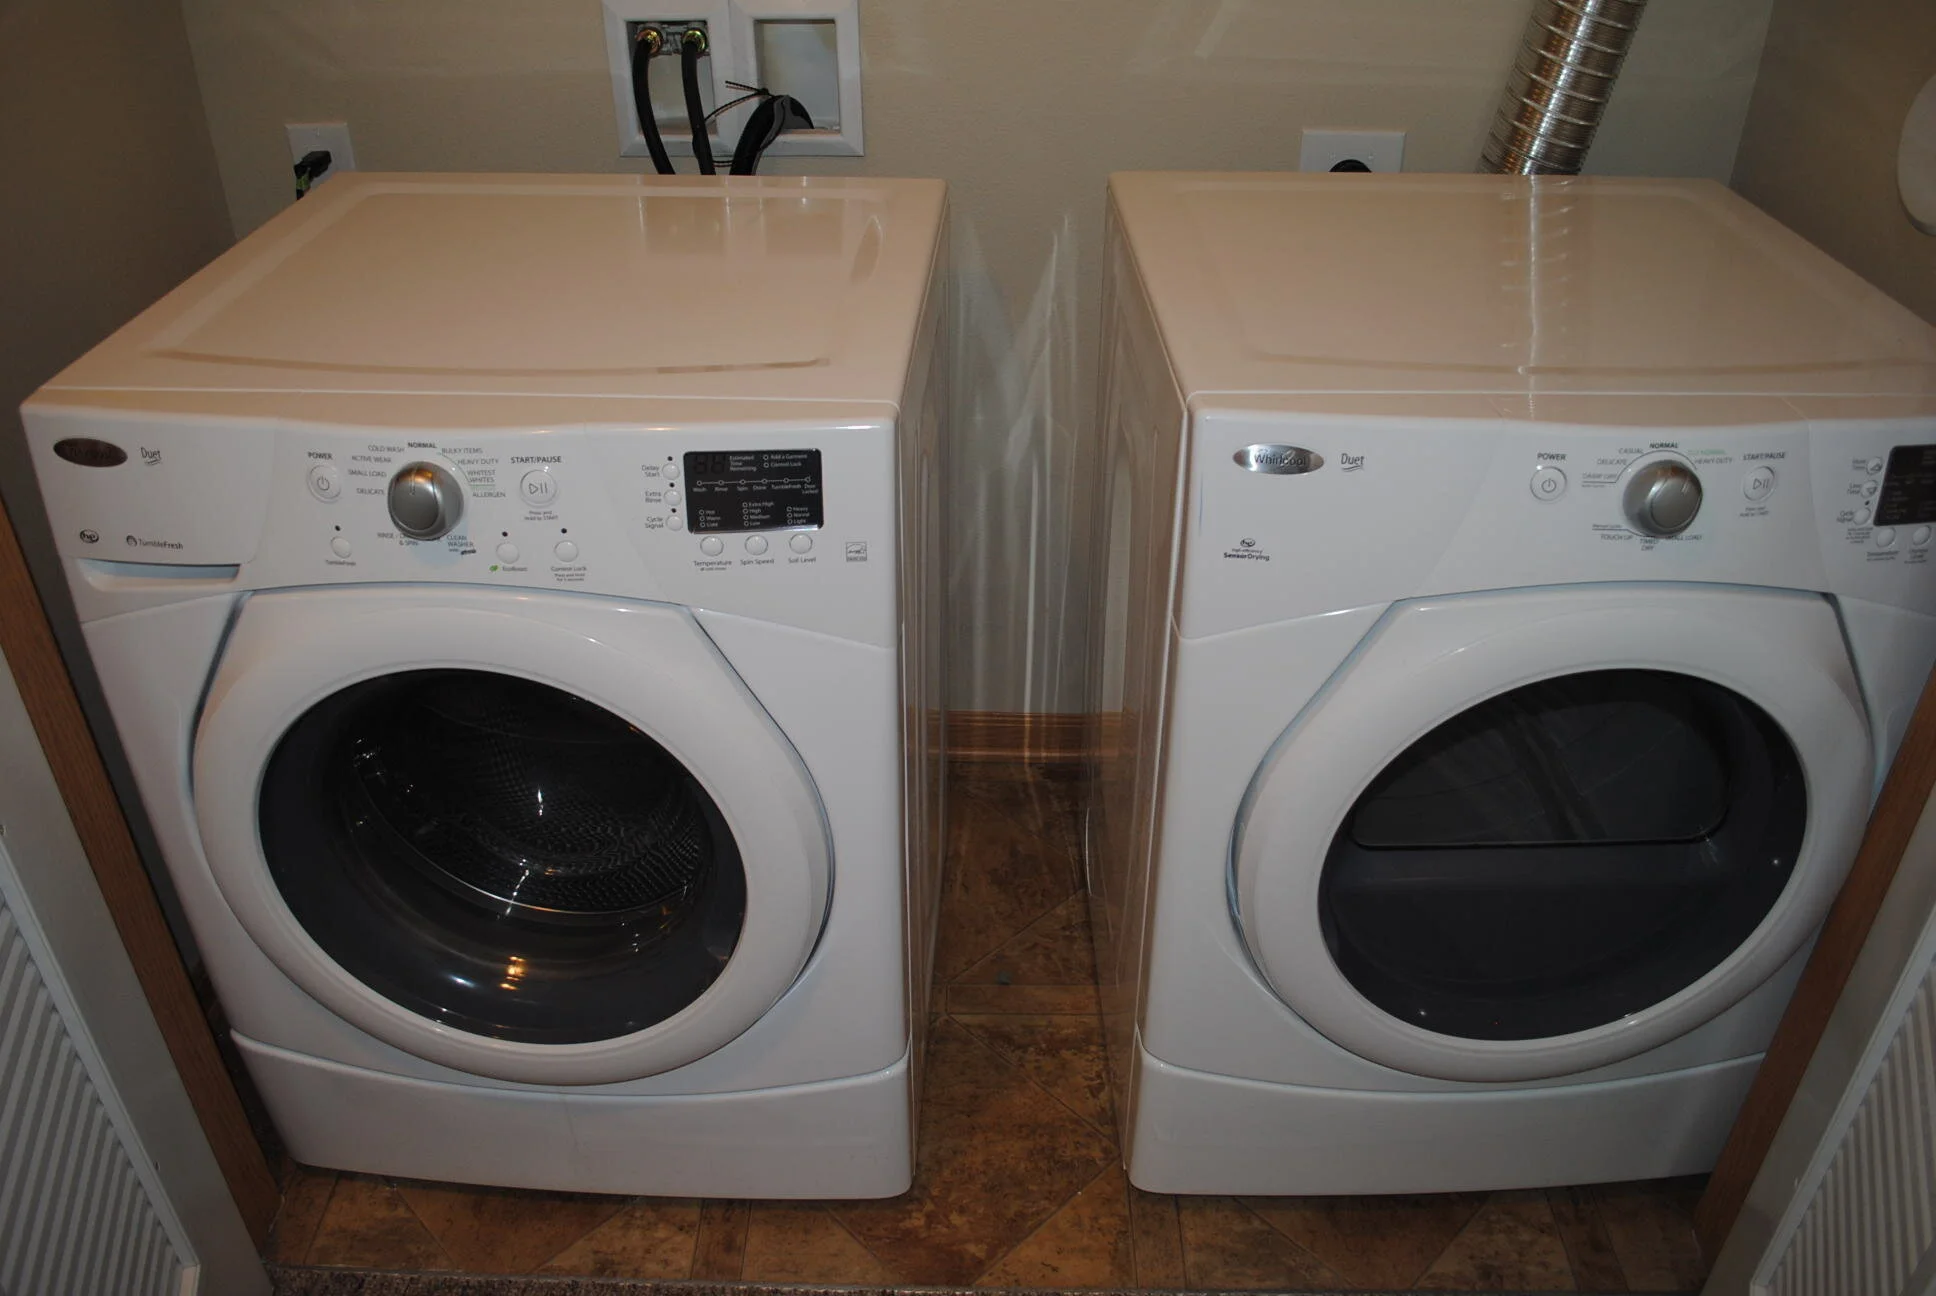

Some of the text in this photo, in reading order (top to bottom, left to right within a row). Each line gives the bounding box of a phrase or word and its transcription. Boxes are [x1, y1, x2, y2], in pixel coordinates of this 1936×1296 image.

[367, 445, 405, 453] COLD WASH
[307, 451, 334, 460] POWER
[510, 455, 562, 464] START/PAUSE
[1340, 452, 1365, 465] Duet
[1537, 453, 1567, 461] POWER
[1743, 452, 1785, 461] START/PAUSE
[641, 464, 660, 472] Delay
[347, 468, 387, 478] SMALL LOAD
[644, 522, 664, 530] Signal
[693, 559, 733, 568] Temperature
[740, 558, 775, 567] Spin Speed
[788, 556, 817, 564] Soil Level
